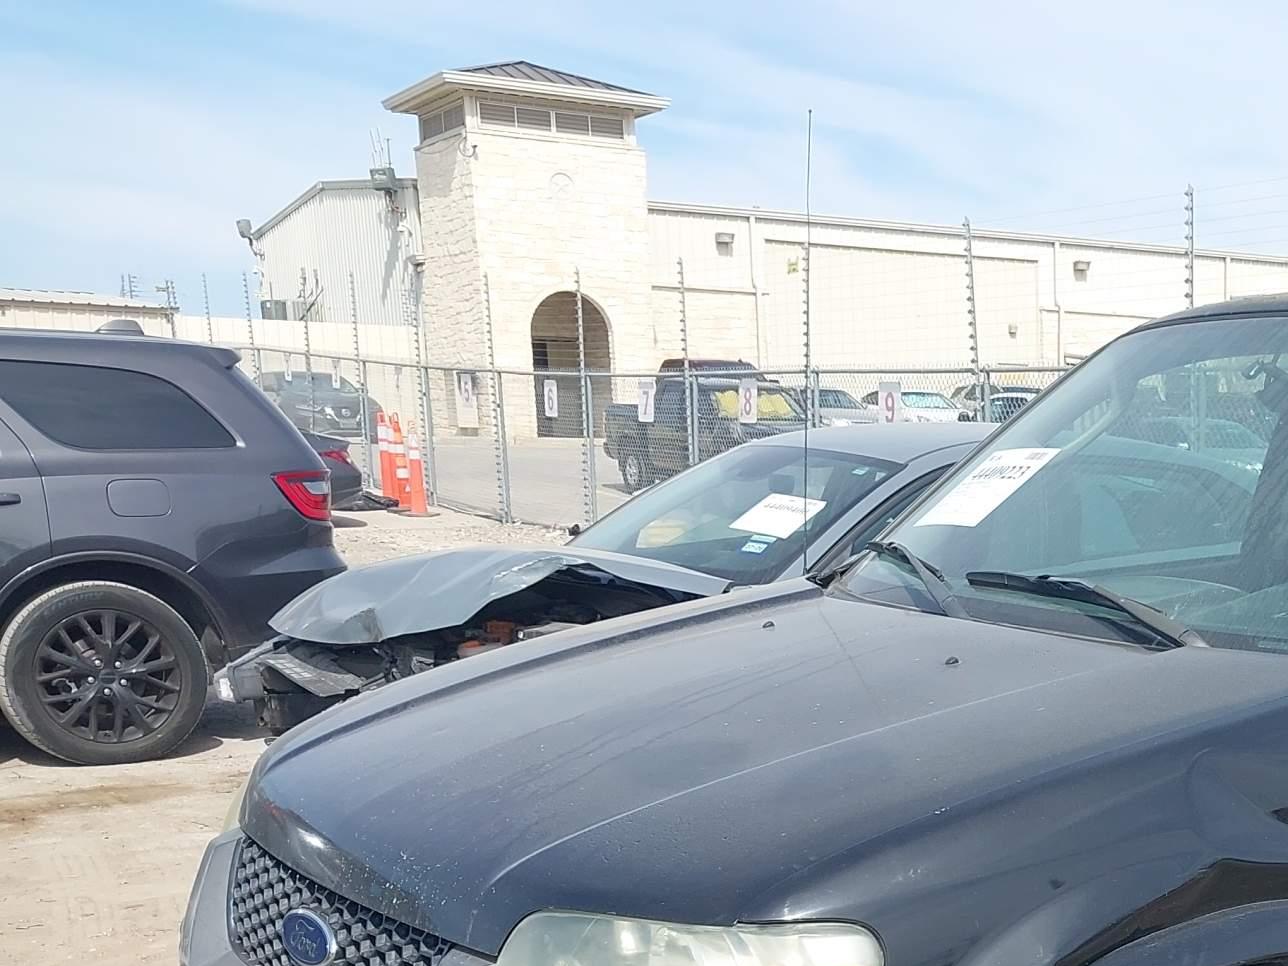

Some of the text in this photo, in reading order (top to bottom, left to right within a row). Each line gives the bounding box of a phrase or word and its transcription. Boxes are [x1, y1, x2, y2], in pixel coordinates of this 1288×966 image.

[463, 381, 470, 402] 5
[547, 388, 554, 411] 6
[642, 390, 650, 416] 7
[744, 388, 752, 416] 8
[885, 391, 895, 423] 9
